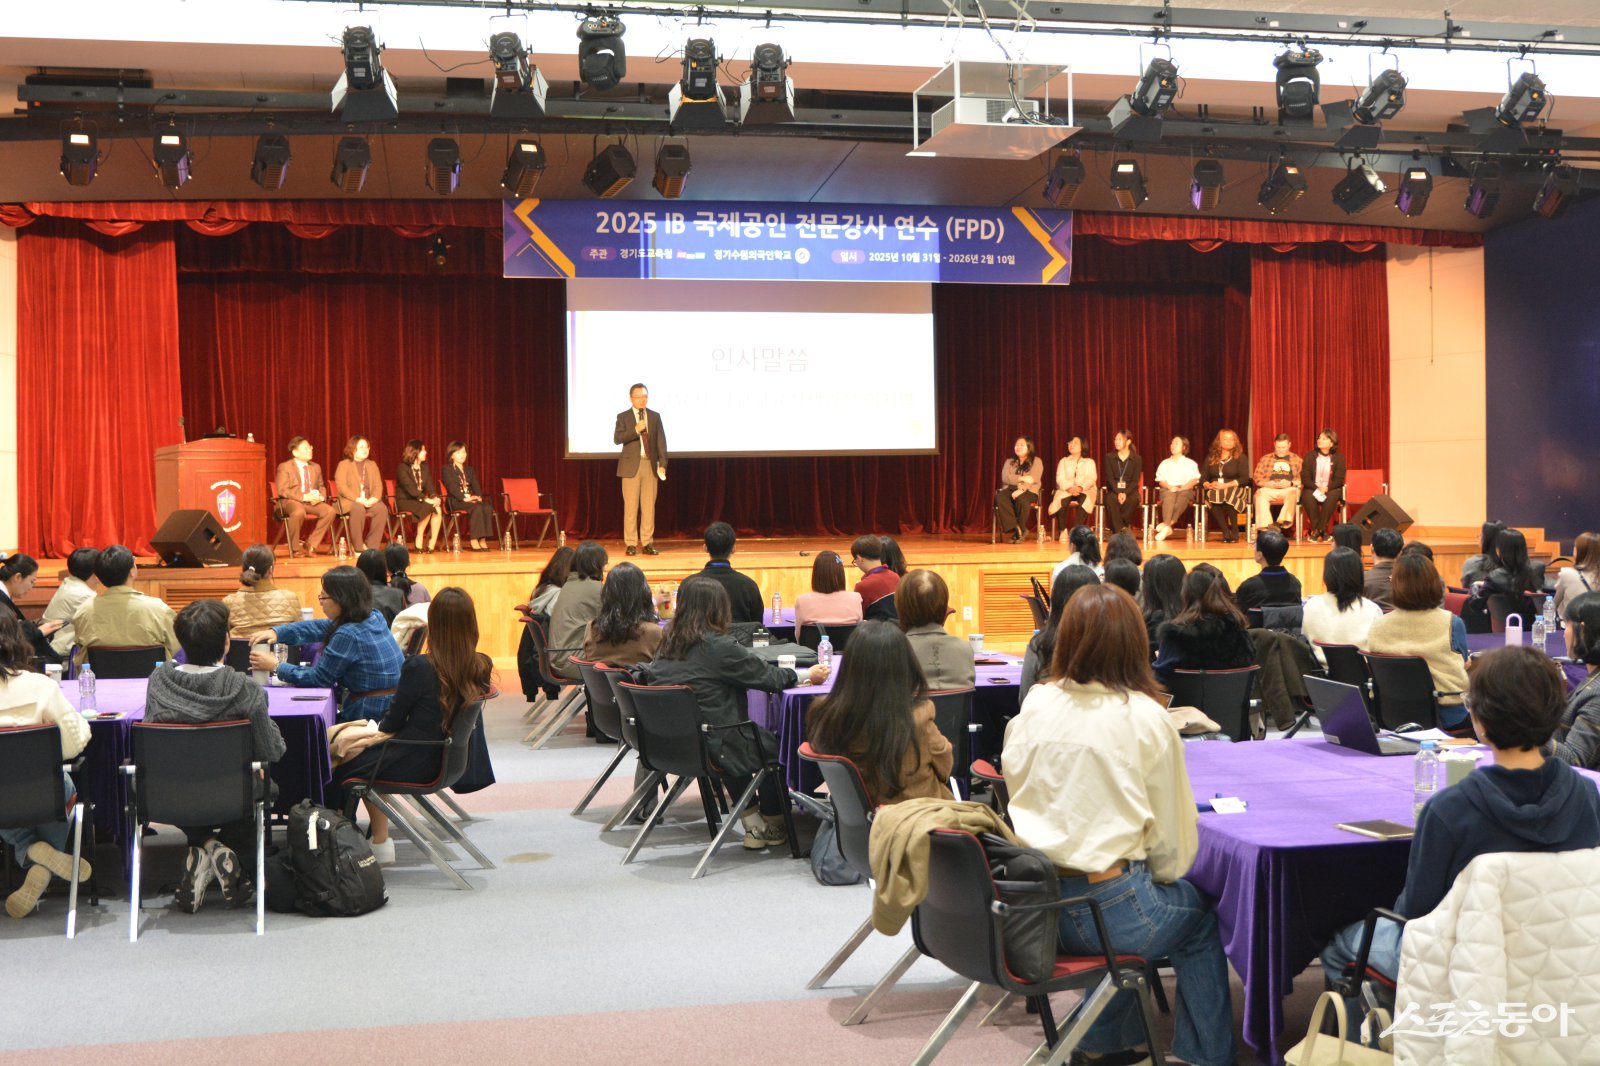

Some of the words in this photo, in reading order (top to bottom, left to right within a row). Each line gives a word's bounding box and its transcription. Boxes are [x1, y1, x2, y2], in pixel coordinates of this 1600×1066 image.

[596, 211, 657, 234] 2025
[665, 212, 685, 235] IB
[693, 211, 785, 238] 국제공인
[795, 213, 885, 240] 전문강사
[894, 215, 939, 241] 연수
[946, 216, 1005, 243] (FPD)
[589, 249, 608, 260] 주관
[620, 248, 672, 260] 경기도교육청
[714, 249, 792, 261] 경기수원외국인학교
[840, 250, 858, 263] 일시
[869, 252, 898, 263] 2025년
[901, 252, 920, 263] 10월
[922, 252, 941, 264] 31일
[949, 254, 979, 264] 2026년
[981, 254, 994, 265] 2월
[997, 255, 1016, 265] 10일
[711, 346, 809, 373] 인사말씀
